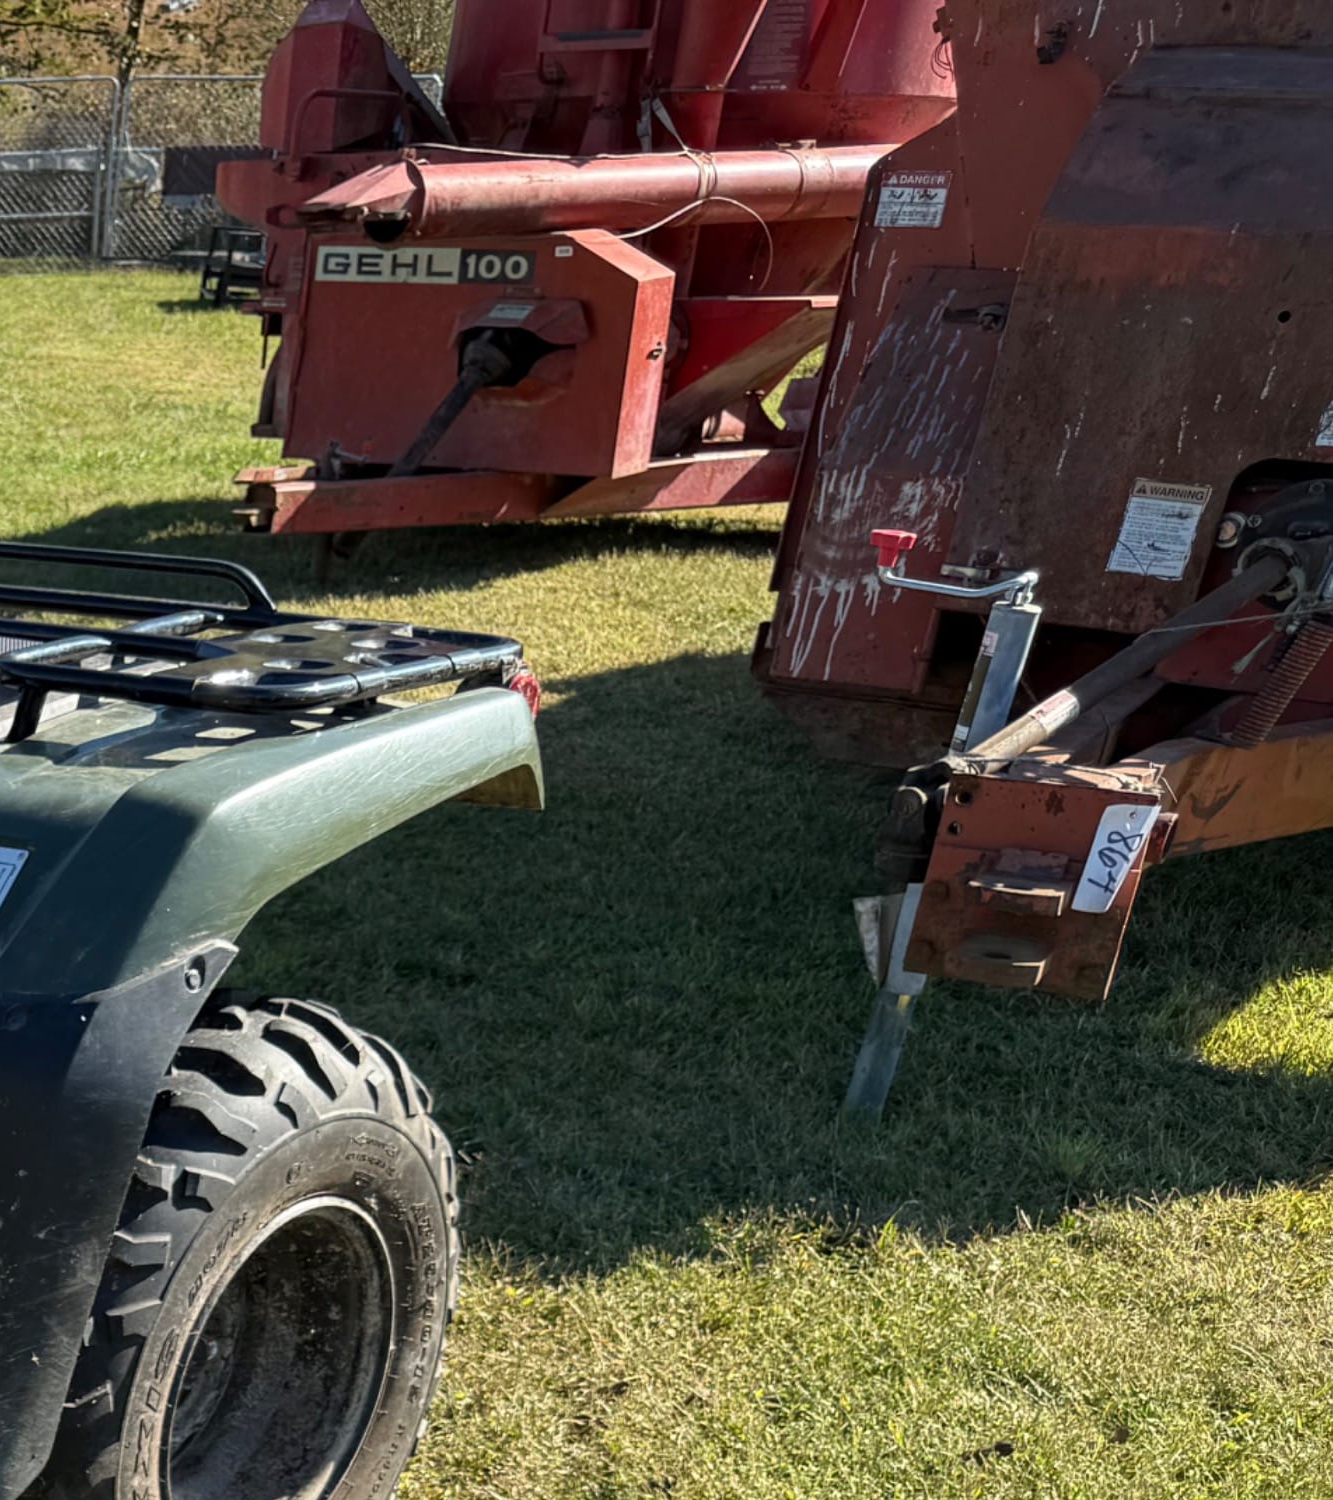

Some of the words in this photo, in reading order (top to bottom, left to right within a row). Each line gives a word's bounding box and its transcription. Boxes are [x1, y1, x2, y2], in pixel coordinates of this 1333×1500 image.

[322, 253, 453, 277] GEHL
[466, 254, 529, 280] 100
[1149, 484, 1205, 501] WARNING
